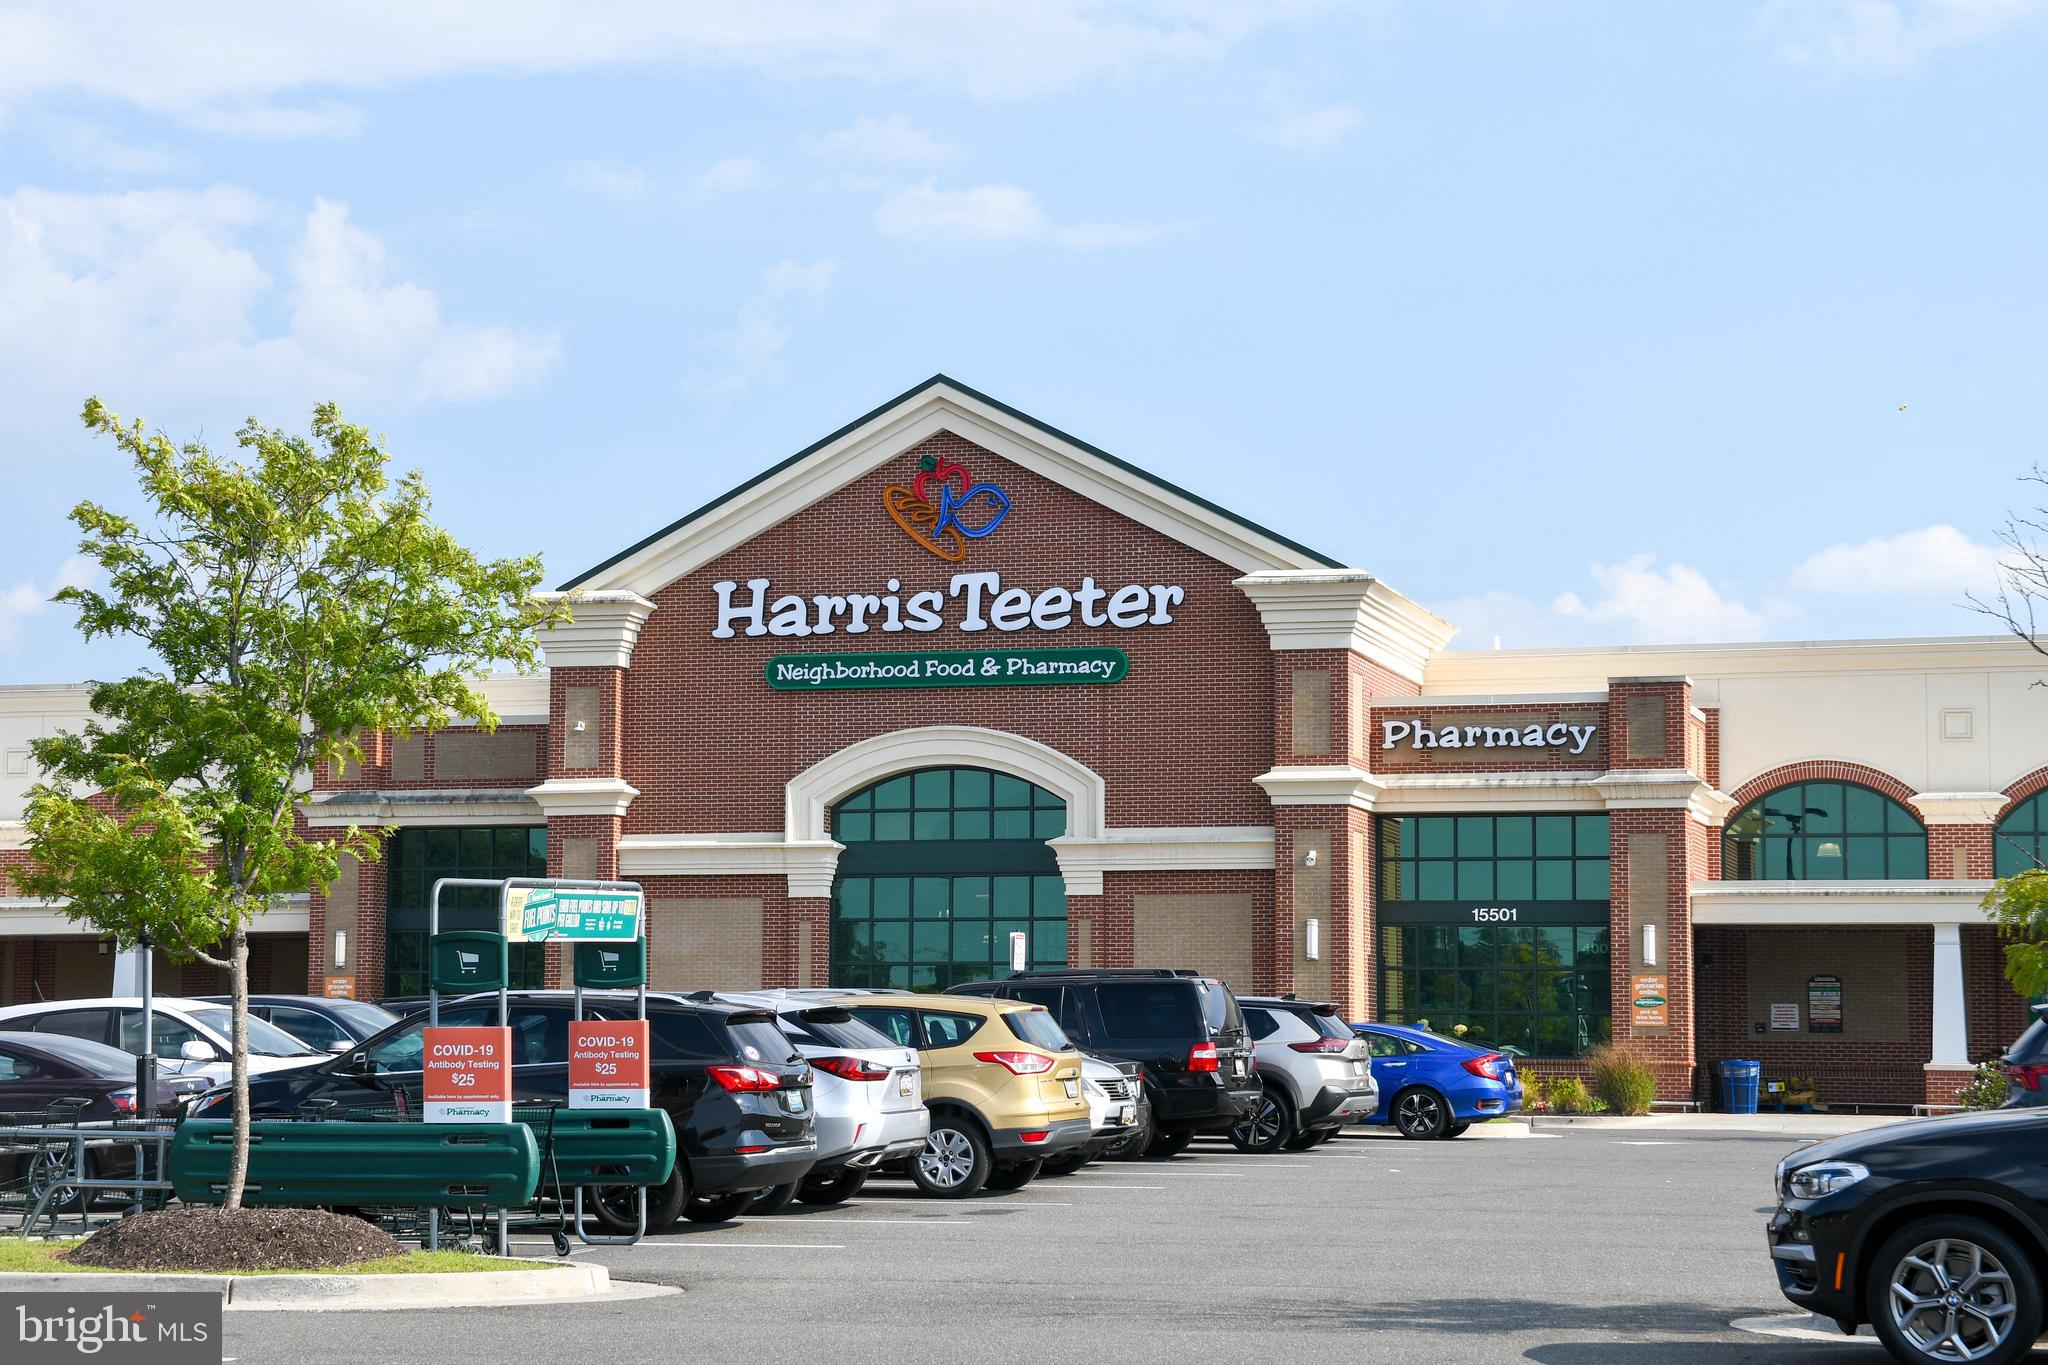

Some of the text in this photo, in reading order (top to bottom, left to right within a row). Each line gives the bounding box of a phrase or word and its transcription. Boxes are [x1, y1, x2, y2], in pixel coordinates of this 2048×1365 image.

[712, 571, 1185, 639] Harris Teeter
[775, 655, 1117, 684] Neighborhood Food & Pharmacy
[1381, 719, 1597, 755] Pharmacy
[524, 907, 537, 929] FUEL
[536, 903, 557, 927] POINTS
[1471, 908, 1517, 922] 15501
[578, 1036, 634, 1047] COVID-19
[433, 1044, 494, 1056] COVID-19
[574, 1051, 640, 1060] Antibody Testing
[428, 1060, 500, 1070] Antibody Testing
[595, 1062, 617, 1075] $25
[451, 1072, 475, 1086] $25
[590, 1094, 631, 1103] Pharmacy
[446, 1107, 490, 1117] Pharmacy
